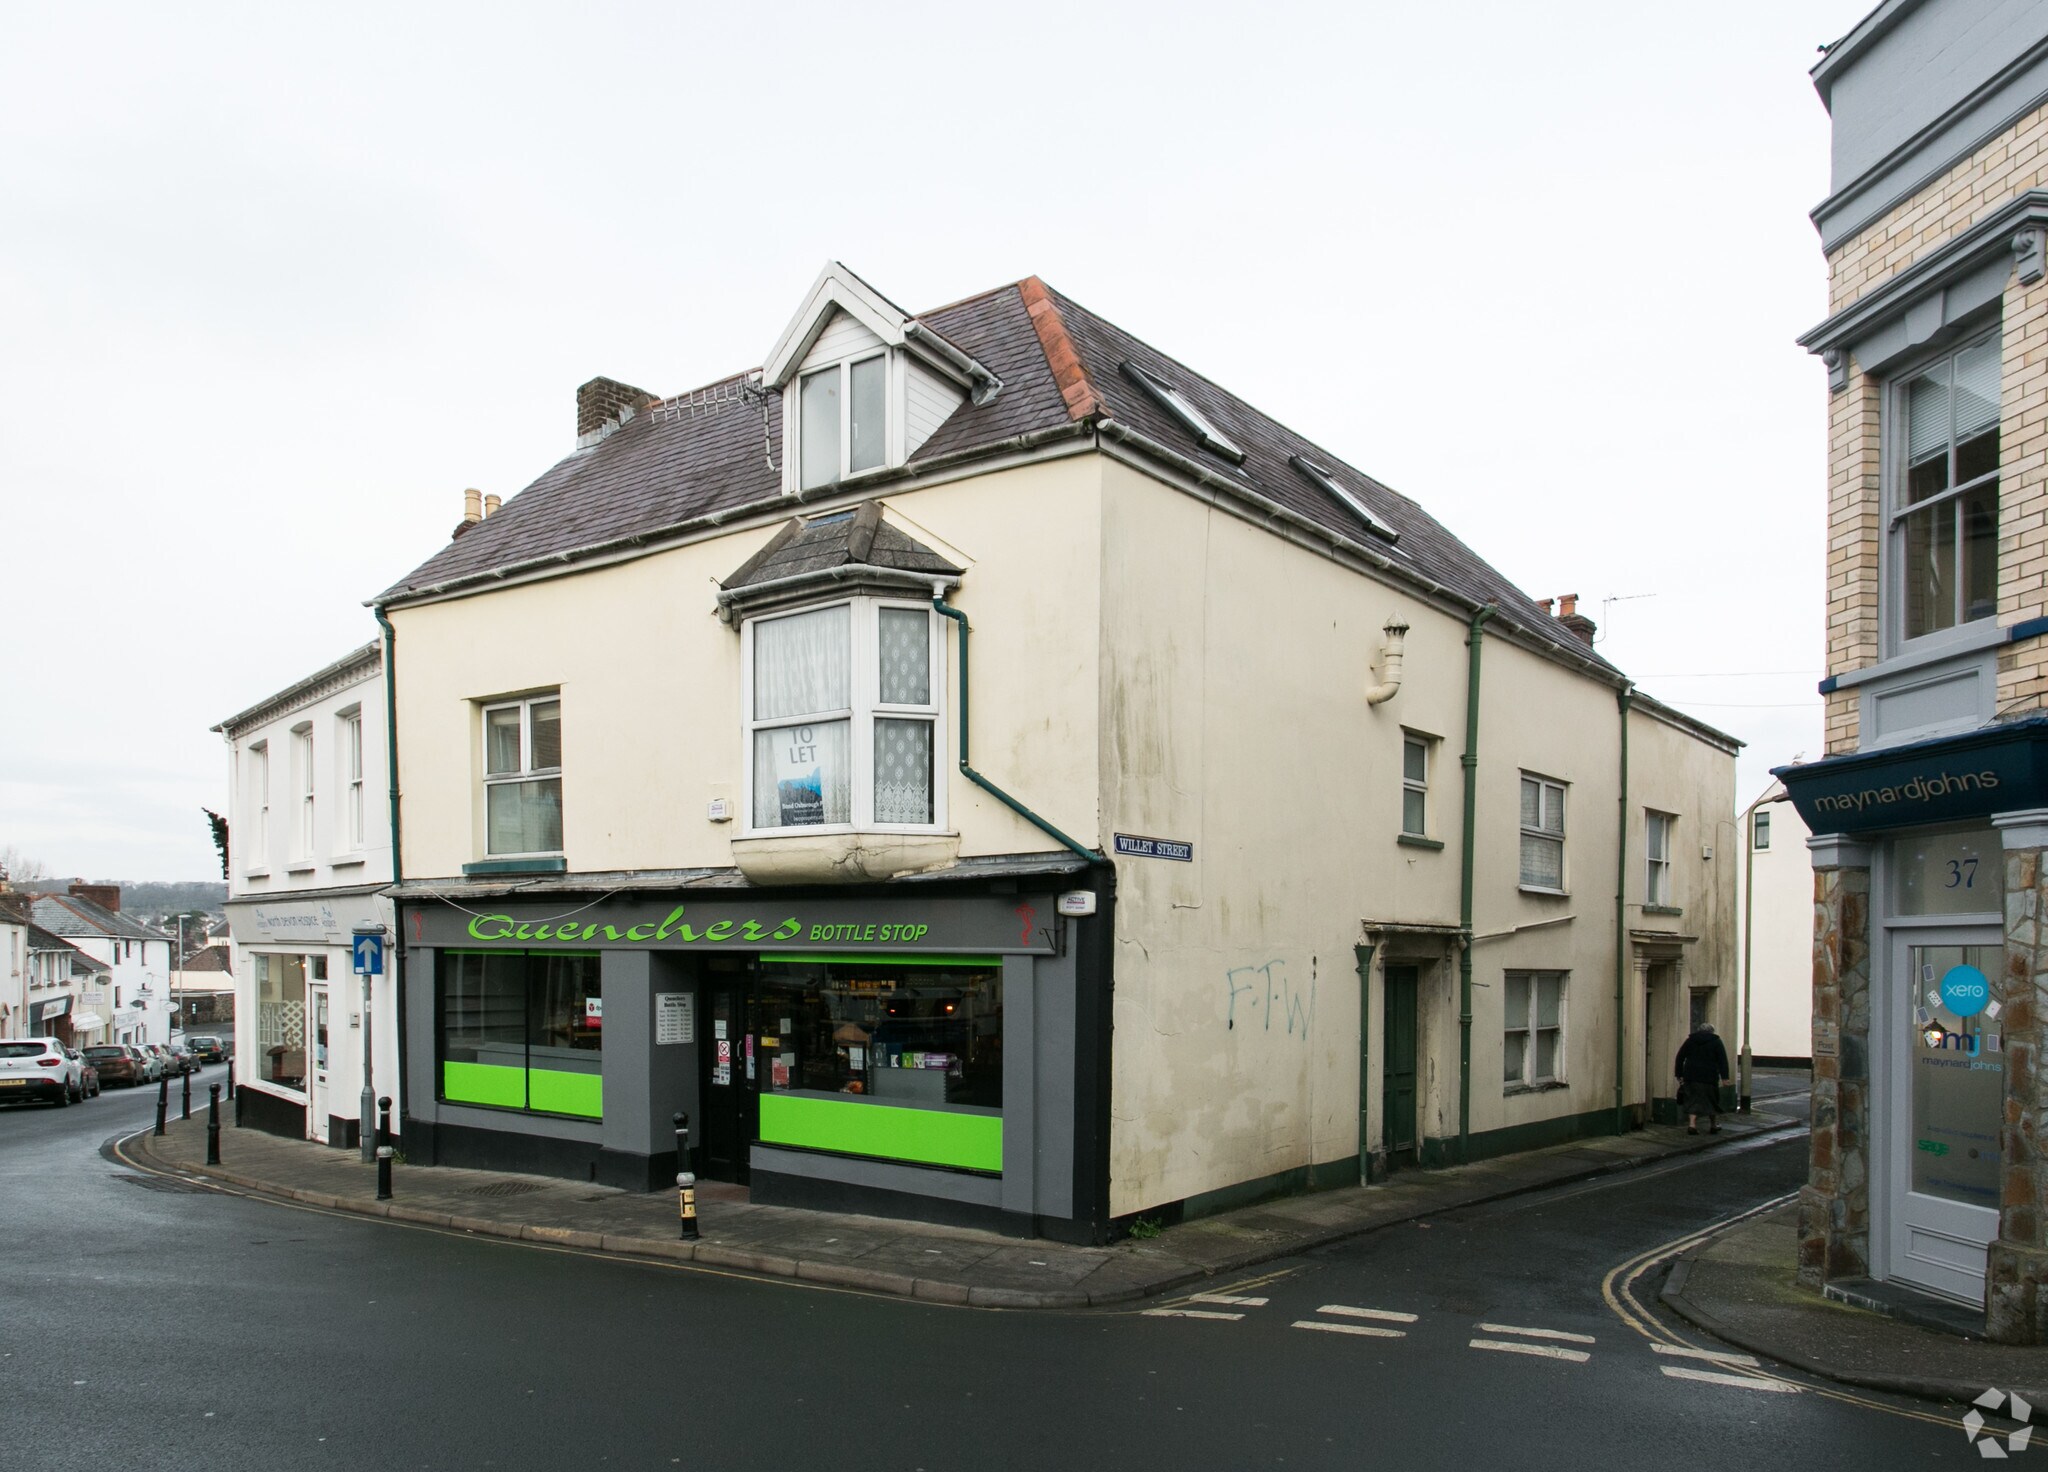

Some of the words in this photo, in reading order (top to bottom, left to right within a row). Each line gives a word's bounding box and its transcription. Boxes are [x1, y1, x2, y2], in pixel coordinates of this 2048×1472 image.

[789, 726, 813, 745] TO
[789, 745, 817, 764] LET
[1814, 770, 2000, 812] maynardjohns
[1119, 837, 1153, 853] WILLET
[1156, 842, 1188, 858] STREET
[1945, 858, 1979, 889] 37
[467, 904, 802, 942] Quenchers
[810, 924, 877, 942] BOTTLE
[879, 923, 928, 942] STOP
[1945, 984, 1984, 998] xero
[1941, 1027, 1981, 1058] mj
[1921, 1056, 2002, 1072] maynardjohns
